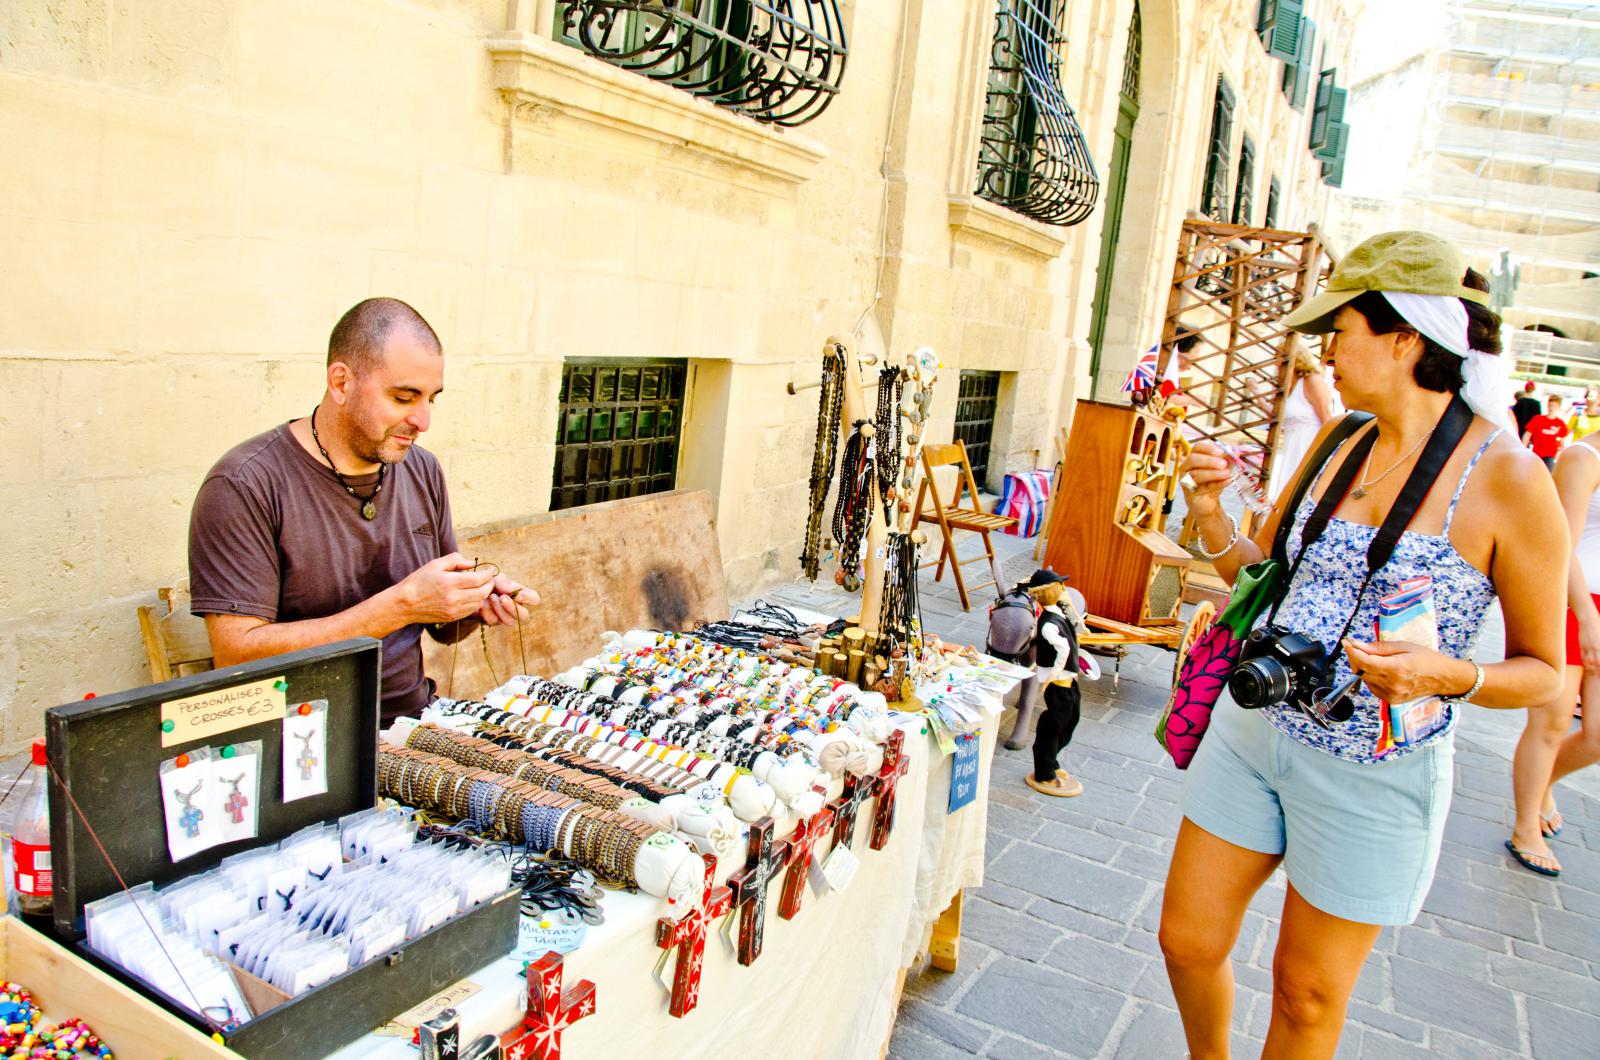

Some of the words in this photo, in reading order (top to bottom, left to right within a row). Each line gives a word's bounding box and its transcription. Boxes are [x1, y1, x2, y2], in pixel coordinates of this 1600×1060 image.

[178, 687, 263, 714] PERSONALISED
[190, 705, 245, 726] CROSSES
[246, 698, 274, 716] €3
[520, 921, 582, 936] MILITARY
